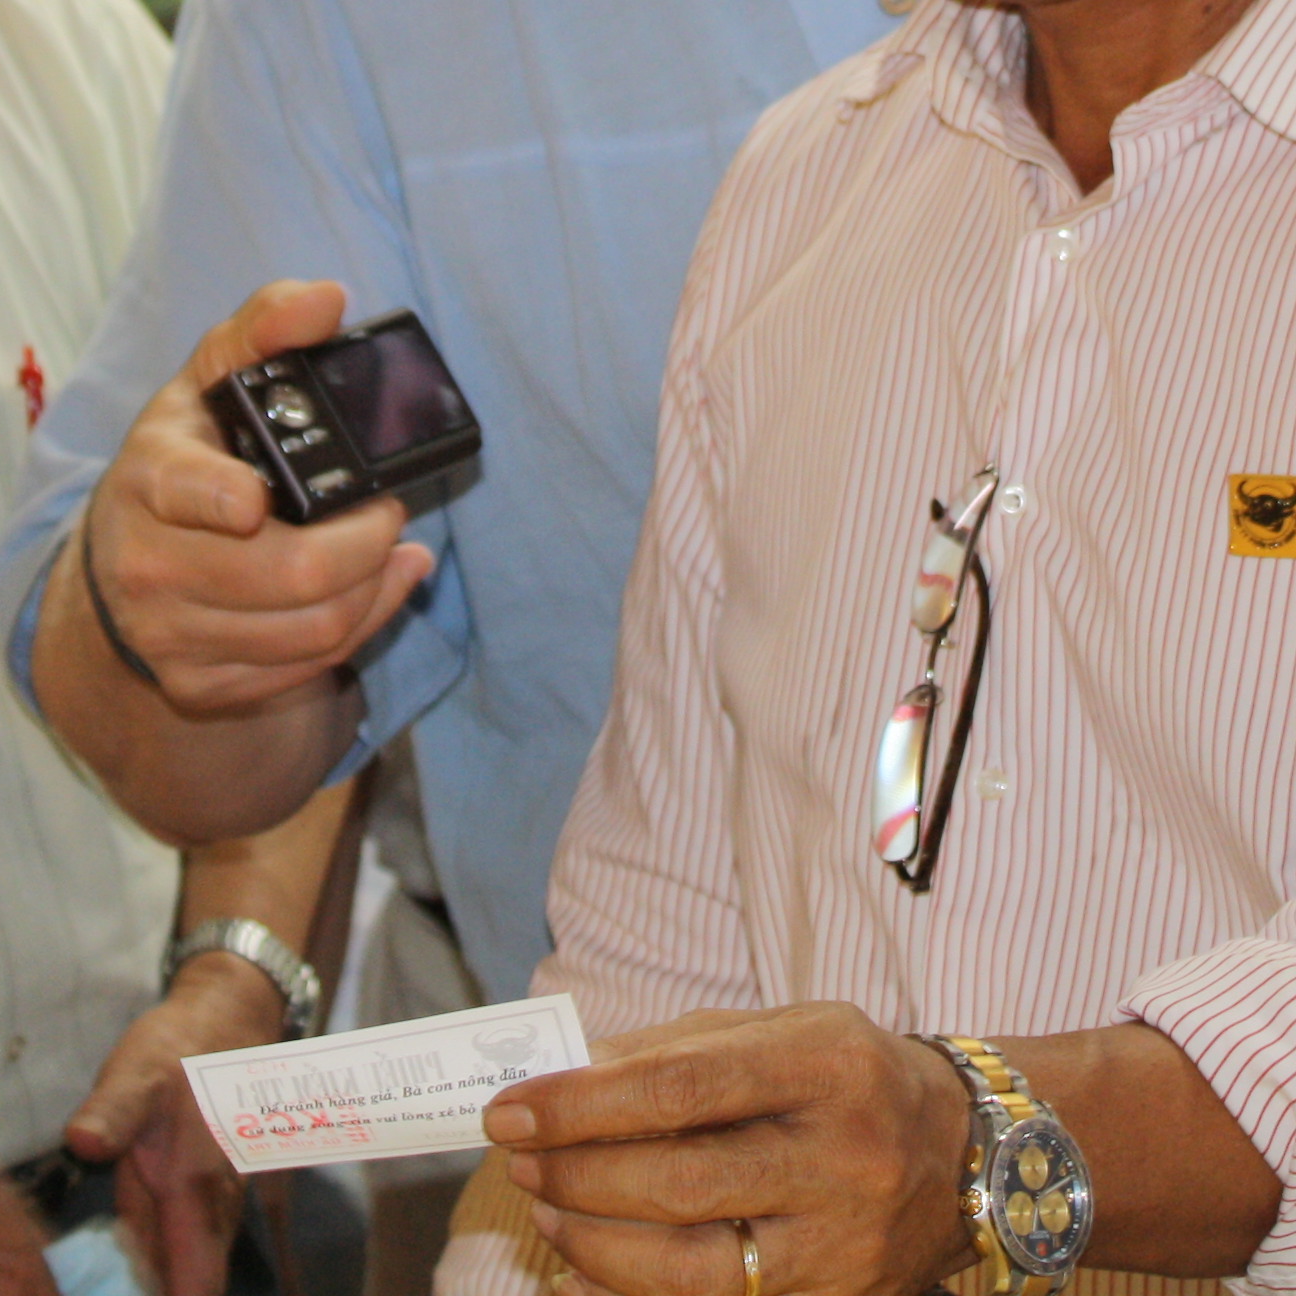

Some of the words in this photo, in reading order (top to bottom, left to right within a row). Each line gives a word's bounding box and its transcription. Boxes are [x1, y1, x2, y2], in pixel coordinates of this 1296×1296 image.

[329, 1091, 366, 1106] hàng
[402, 1084, 423, 1098] Bà
[426, 1081, 454, 1094] con
[458, 1074, 495, 1088] nông
[376, 1111, 398, 1124] vui
[401, 1108, 434, 1123] lòng
